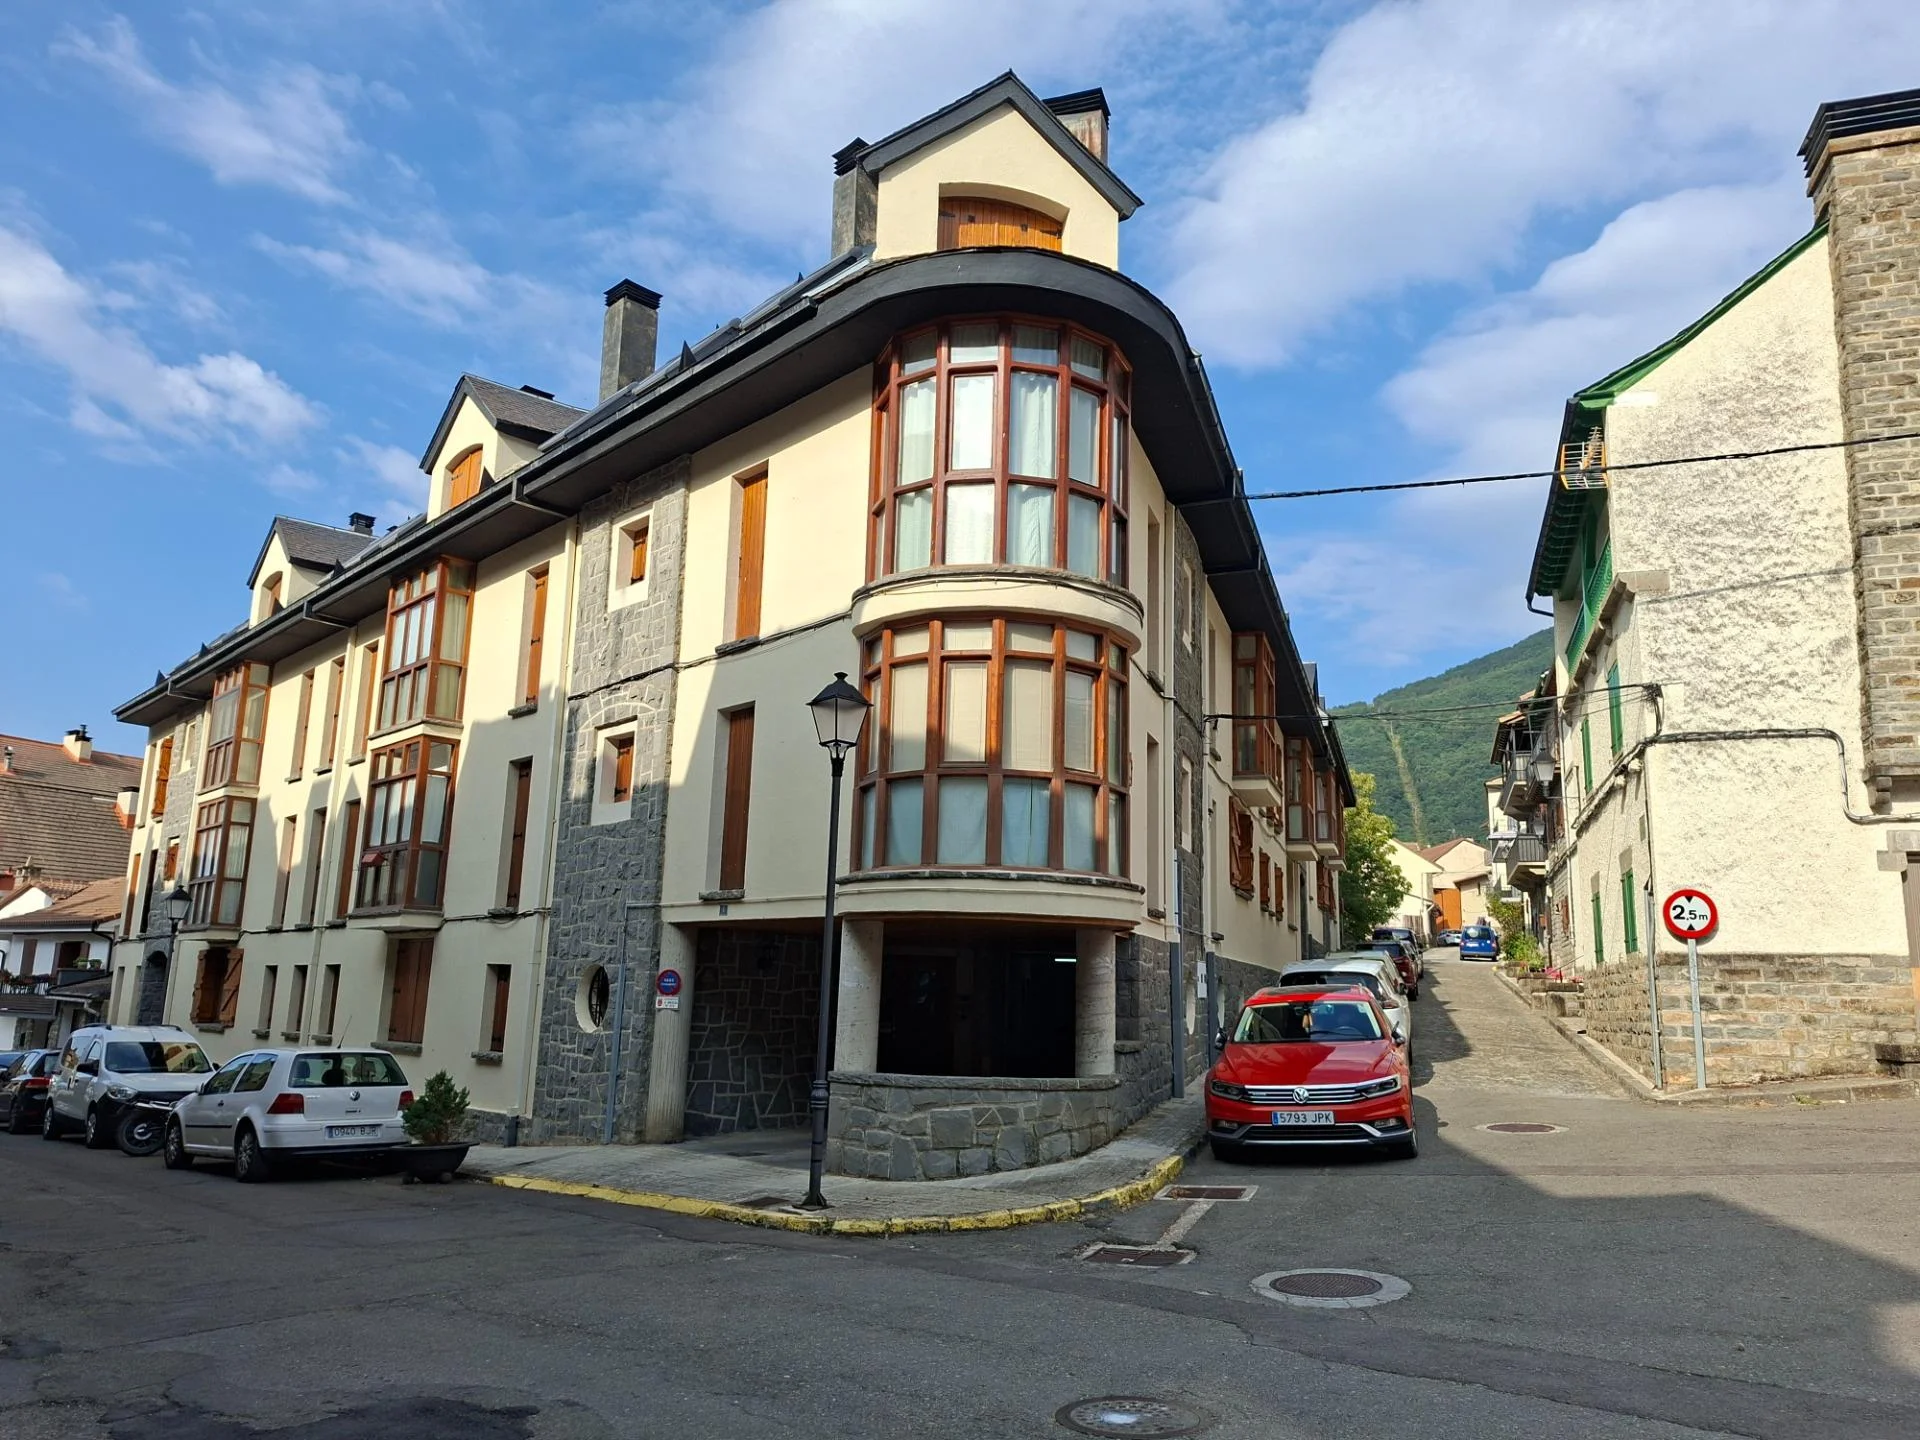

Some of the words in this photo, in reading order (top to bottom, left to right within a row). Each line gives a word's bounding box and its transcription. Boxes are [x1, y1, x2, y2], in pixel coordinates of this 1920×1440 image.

[1279, 1112, 1308, 1123] 5793
[1311, 1112, 1332, 1123] JPK
[334, 1127, 356, 1137] 0940
